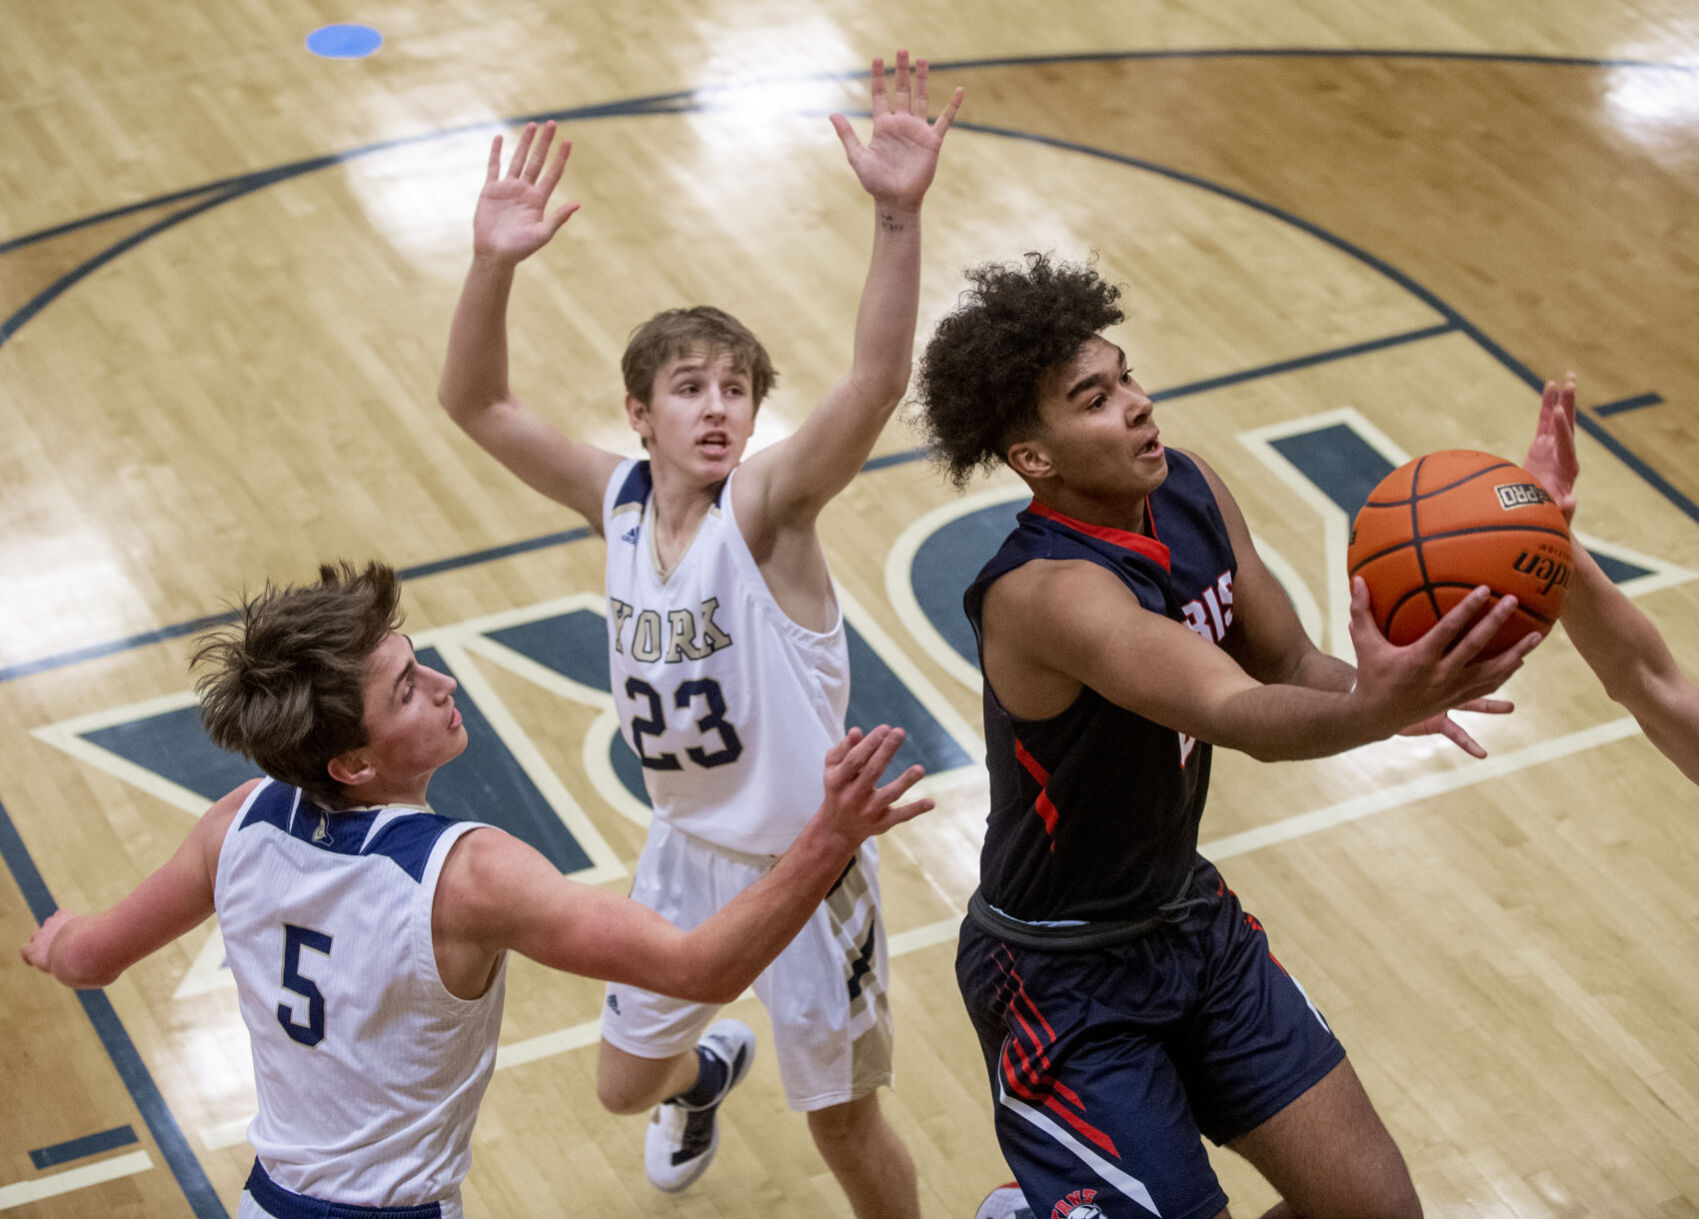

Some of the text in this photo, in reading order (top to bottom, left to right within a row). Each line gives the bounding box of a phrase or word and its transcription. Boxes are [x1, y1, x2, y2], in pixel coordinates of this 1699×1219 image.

[1499, 486, 1539, 506] PRO
[610, 597, 733, 664] YORK
[625, 675, 743, 771] 23
[276, 922, 334, 1050] 5
